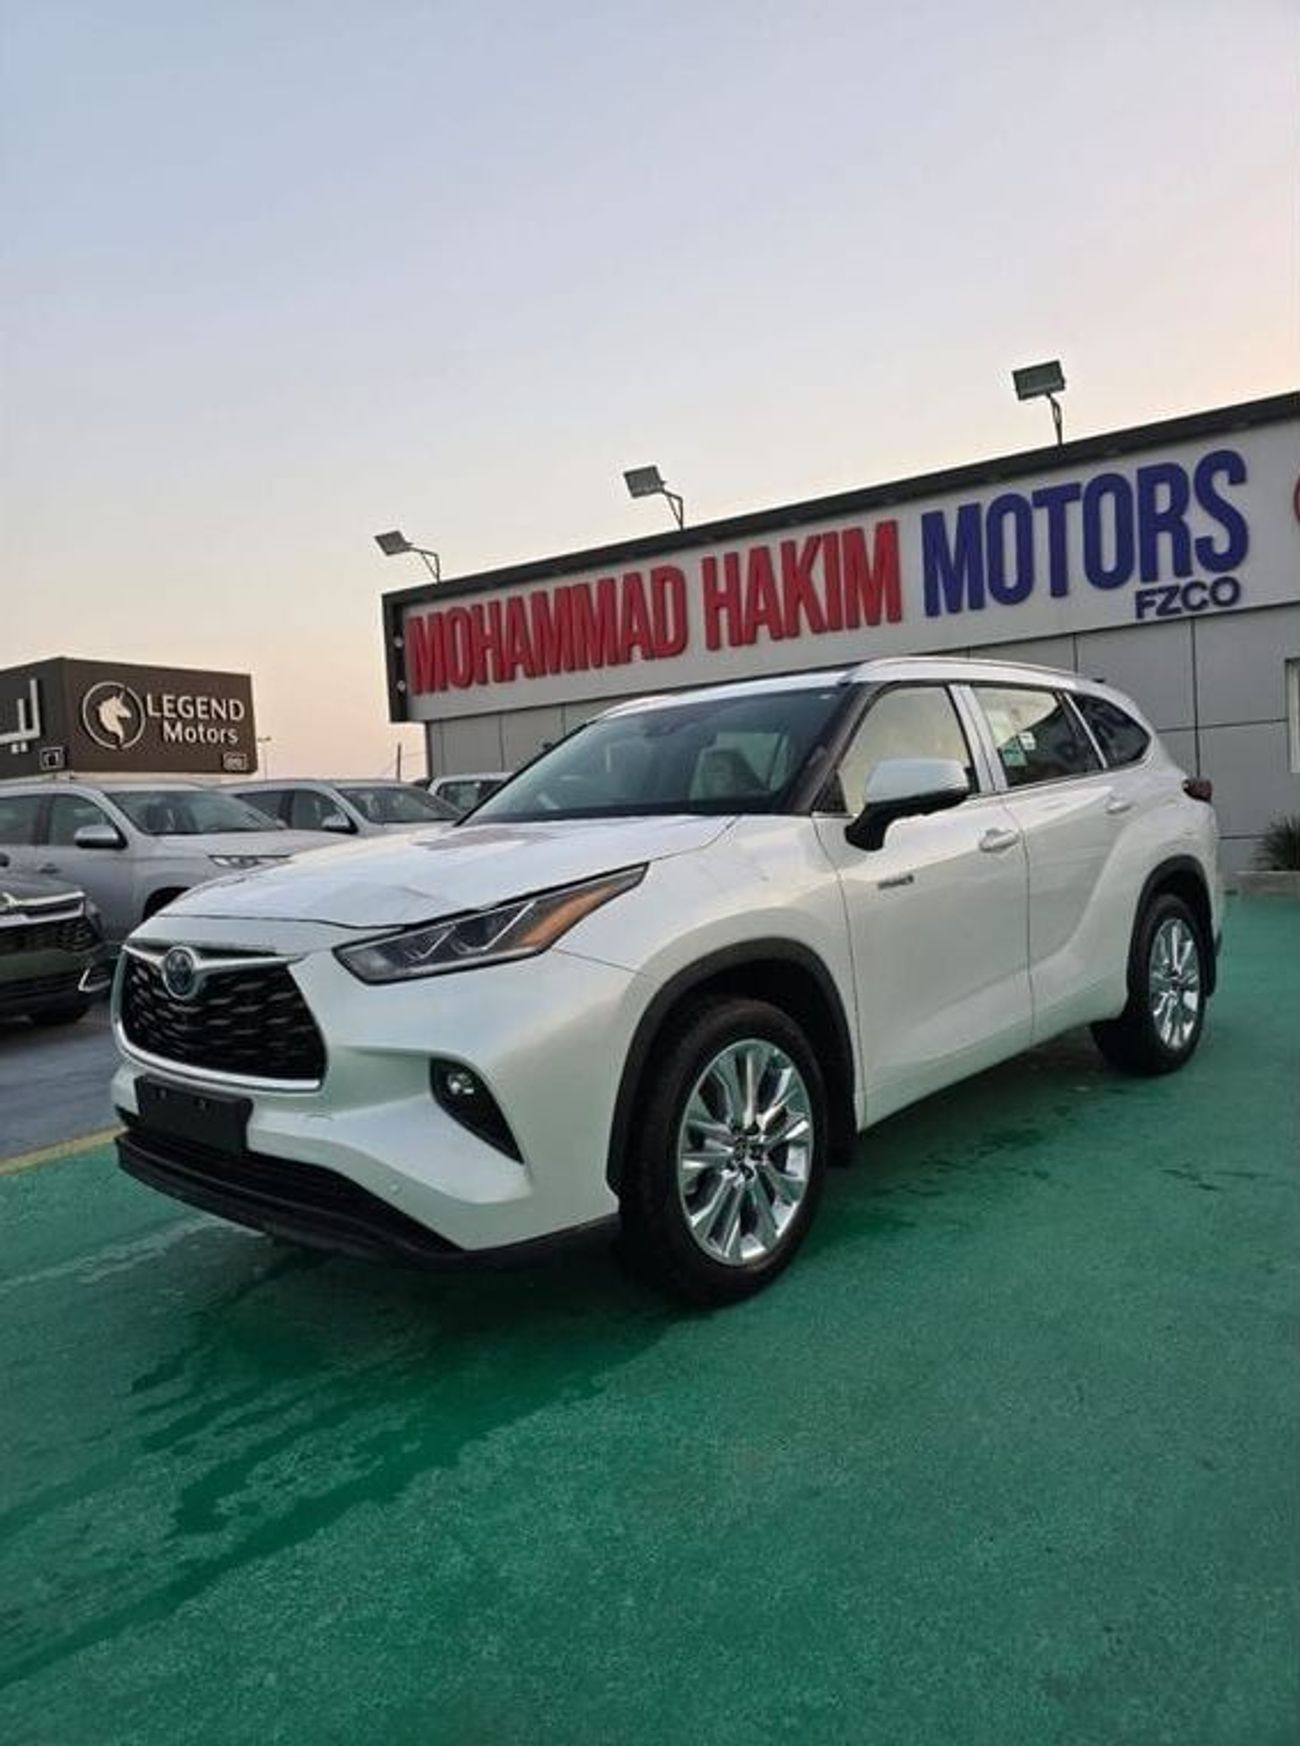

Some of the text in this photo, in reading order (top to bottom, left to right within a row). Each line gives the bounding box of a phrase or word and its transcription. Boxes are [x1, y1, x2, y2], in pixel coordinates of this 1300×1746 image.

[405, 564, 688, 695] MOHAMMAD
[701, 519, 902, 651] HAKIM
[920, 449, 1249, 618] MOTORS
[1135, 576, 1241, 619] FZCO
[146, 693, 245, 721] LEGEND
[162, 721, 239, 744] Motors
